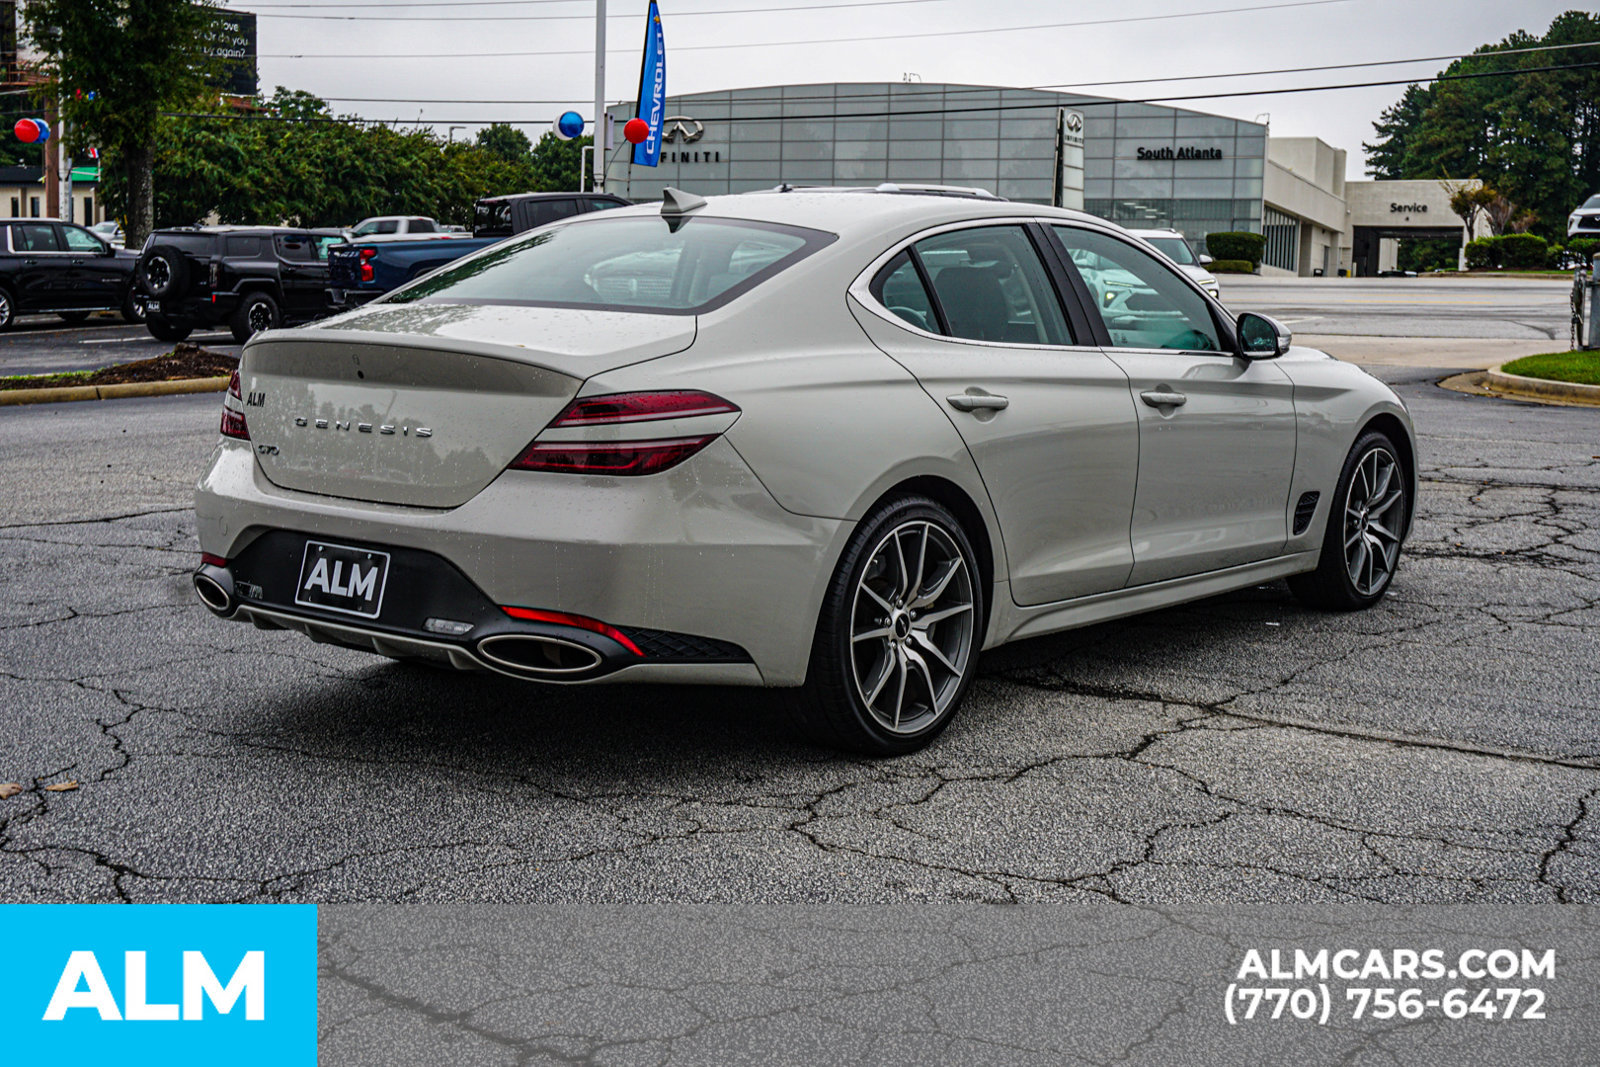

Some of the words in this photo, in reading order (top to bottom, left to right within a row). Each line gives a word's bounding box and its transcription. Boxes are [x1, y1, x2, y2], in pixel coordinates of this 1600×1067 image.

[221, 19, 239, 32] love
[232, 37, 249, 47] you
[216, 47, 246, 59] again?
[646, 33, 664, 155] CHEVROLET
[660, 151, 720, 163] FINITI
[1137, 146, 1175, 161] South
[1177, 147, 1223, 160] Atlanta
[1390, 202, 1428, 213] Service
[246, 392, 266, 407] ALM
[294, 416, 433, 437] GENESIS
[258, 444, 280, 456] G70
[304, 557, 379, 602] ALM
